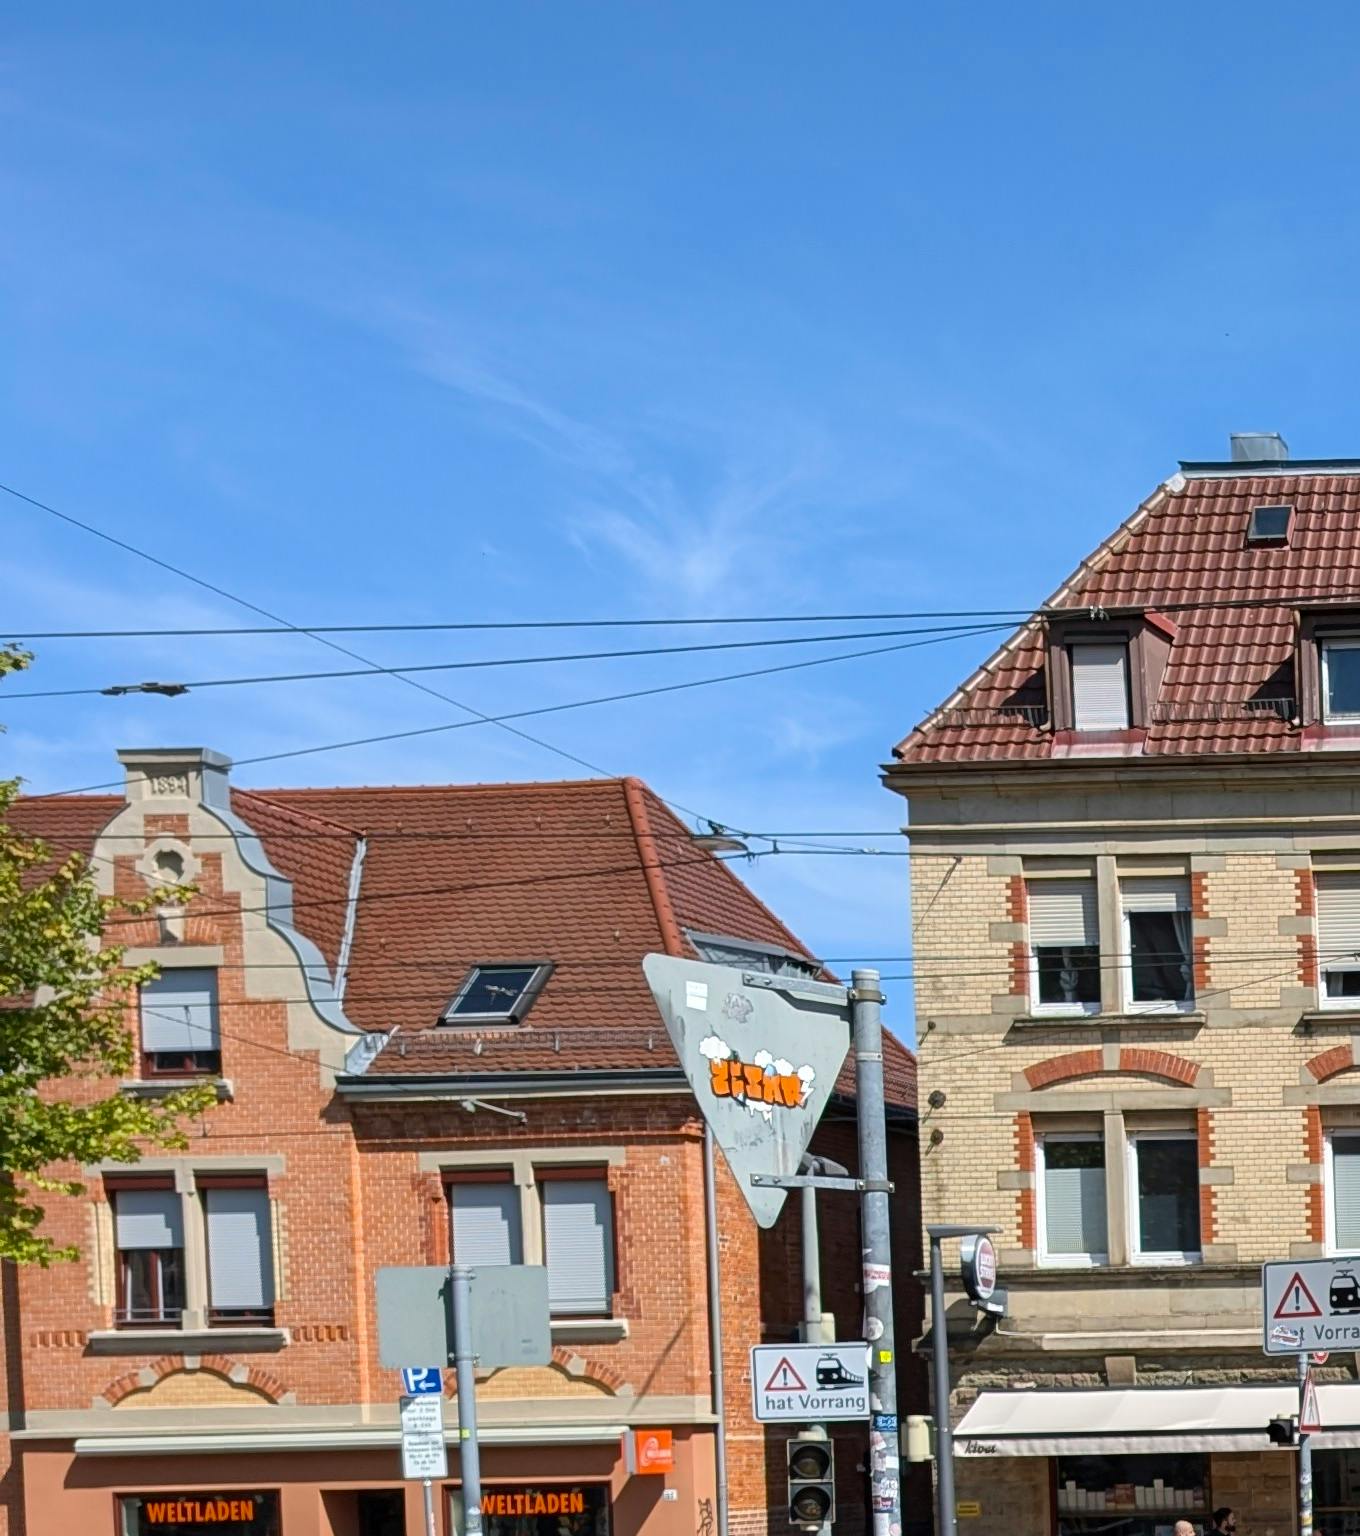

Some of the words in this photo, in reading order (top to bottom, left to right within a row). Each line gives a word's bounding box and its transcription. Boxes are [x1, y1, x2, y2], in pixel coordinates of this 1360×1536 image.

[765, 1396, 794, 1410] hat
[798, 1394, 866, 1412] Vorrang
[146, 1501, 254, 1523] WELTLADEN
[480, 1493, 584, 1515] WELTLADEN
